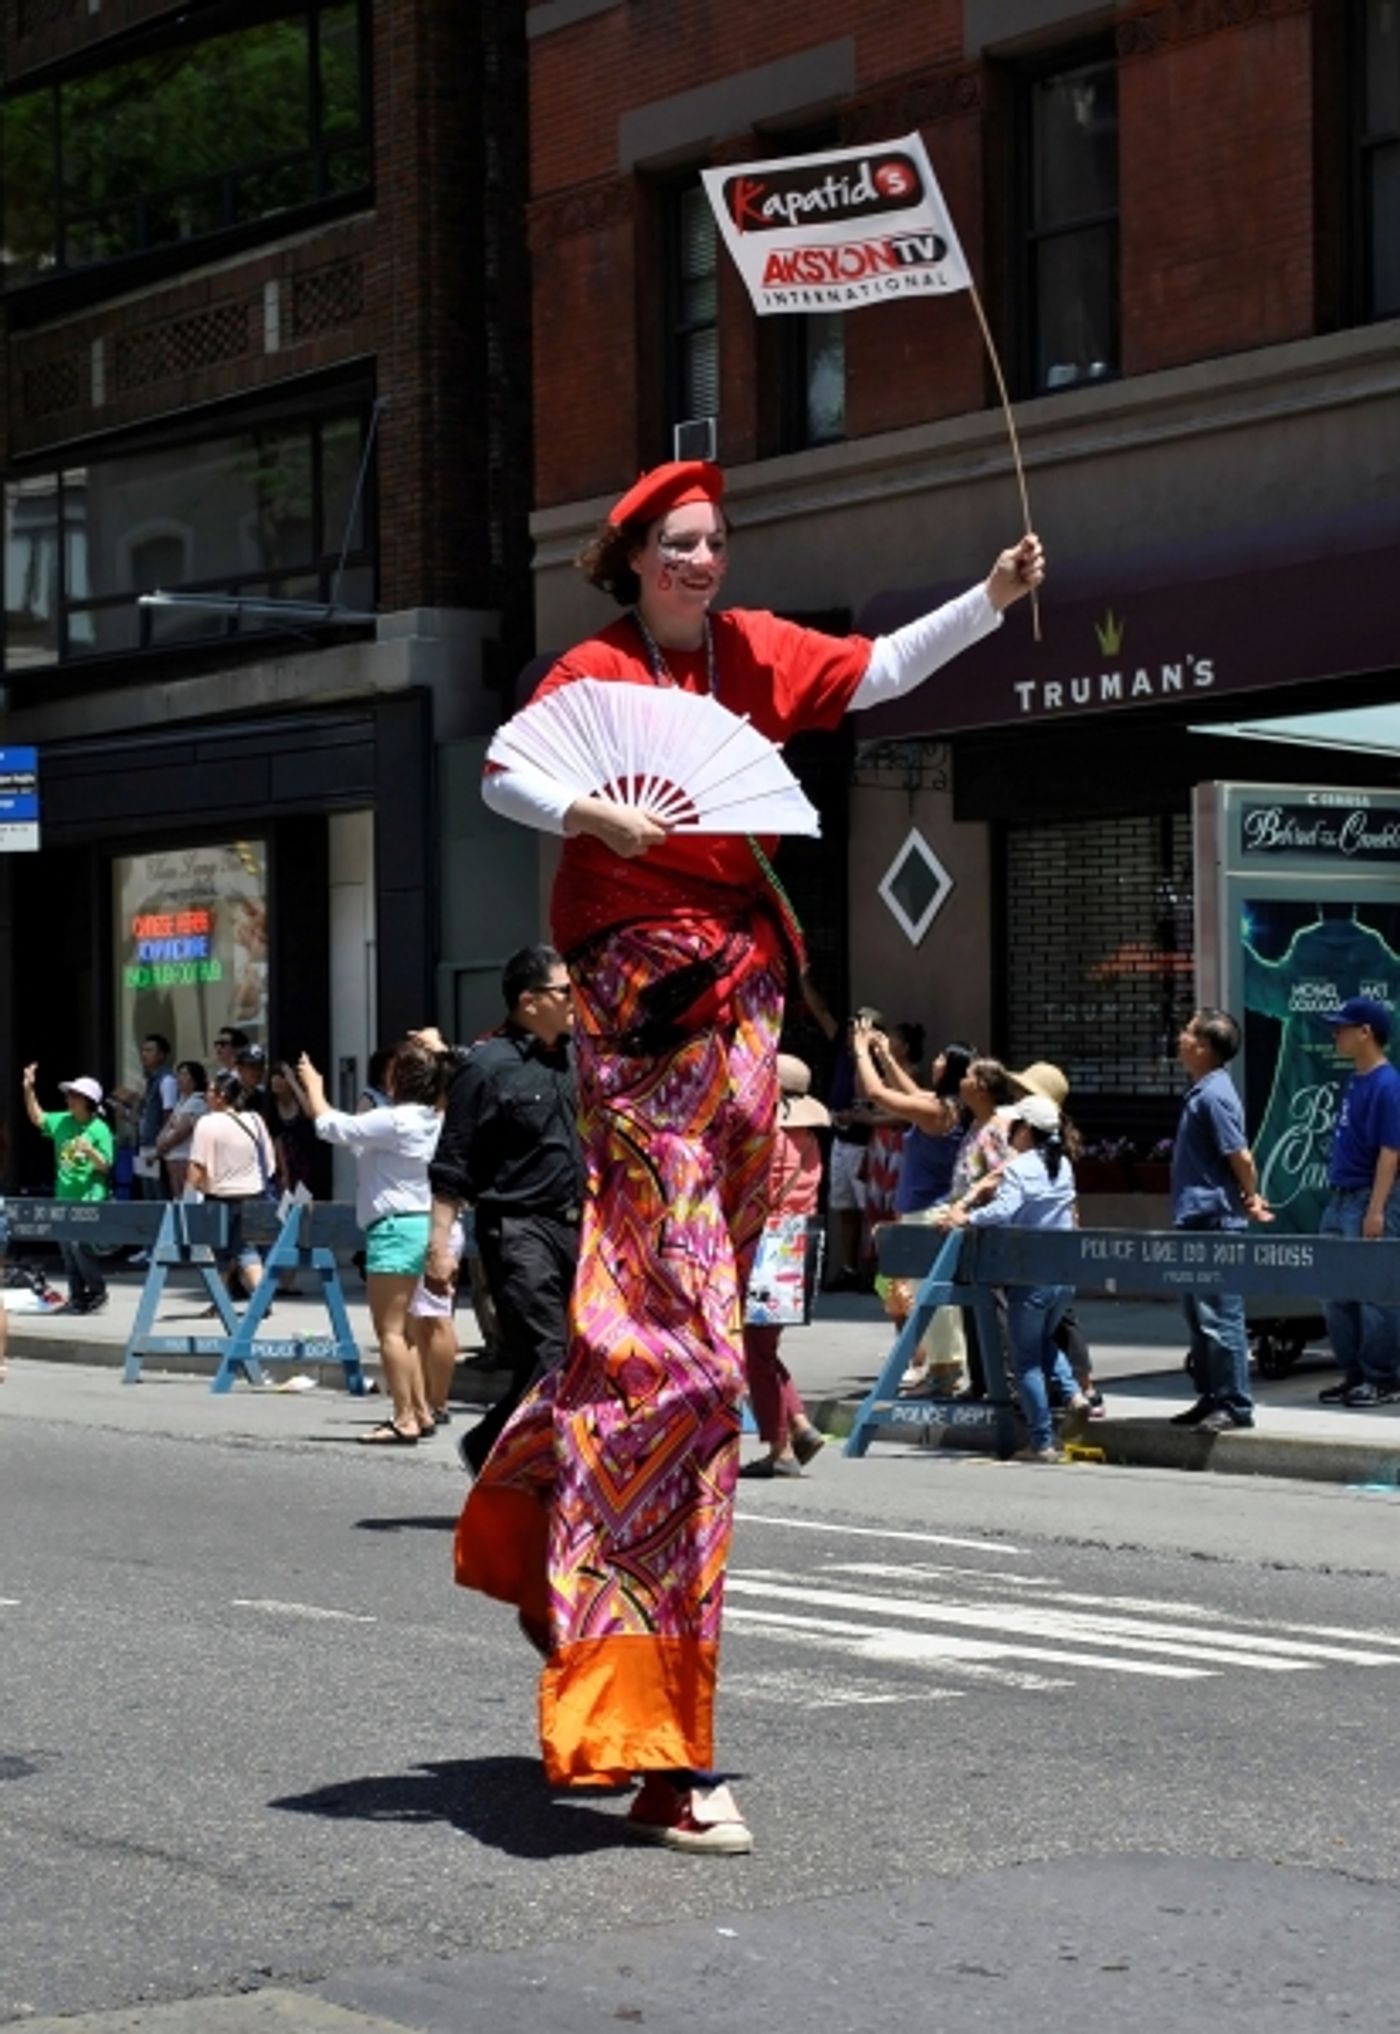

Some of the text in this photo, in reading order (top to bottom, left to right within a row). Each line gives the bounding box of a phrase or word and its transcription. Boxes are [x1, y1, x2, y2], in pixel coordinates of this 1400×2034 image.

[732, 161, 878, 235] Kapatid
[764, 272, 948, 306] INTERNATIONAL
[1014, 653, 1216, 712] TRUMAN'S
[1254, 1244, 1314, 1267] CROSS
[891, 1405, 948, 1426] POLICE
